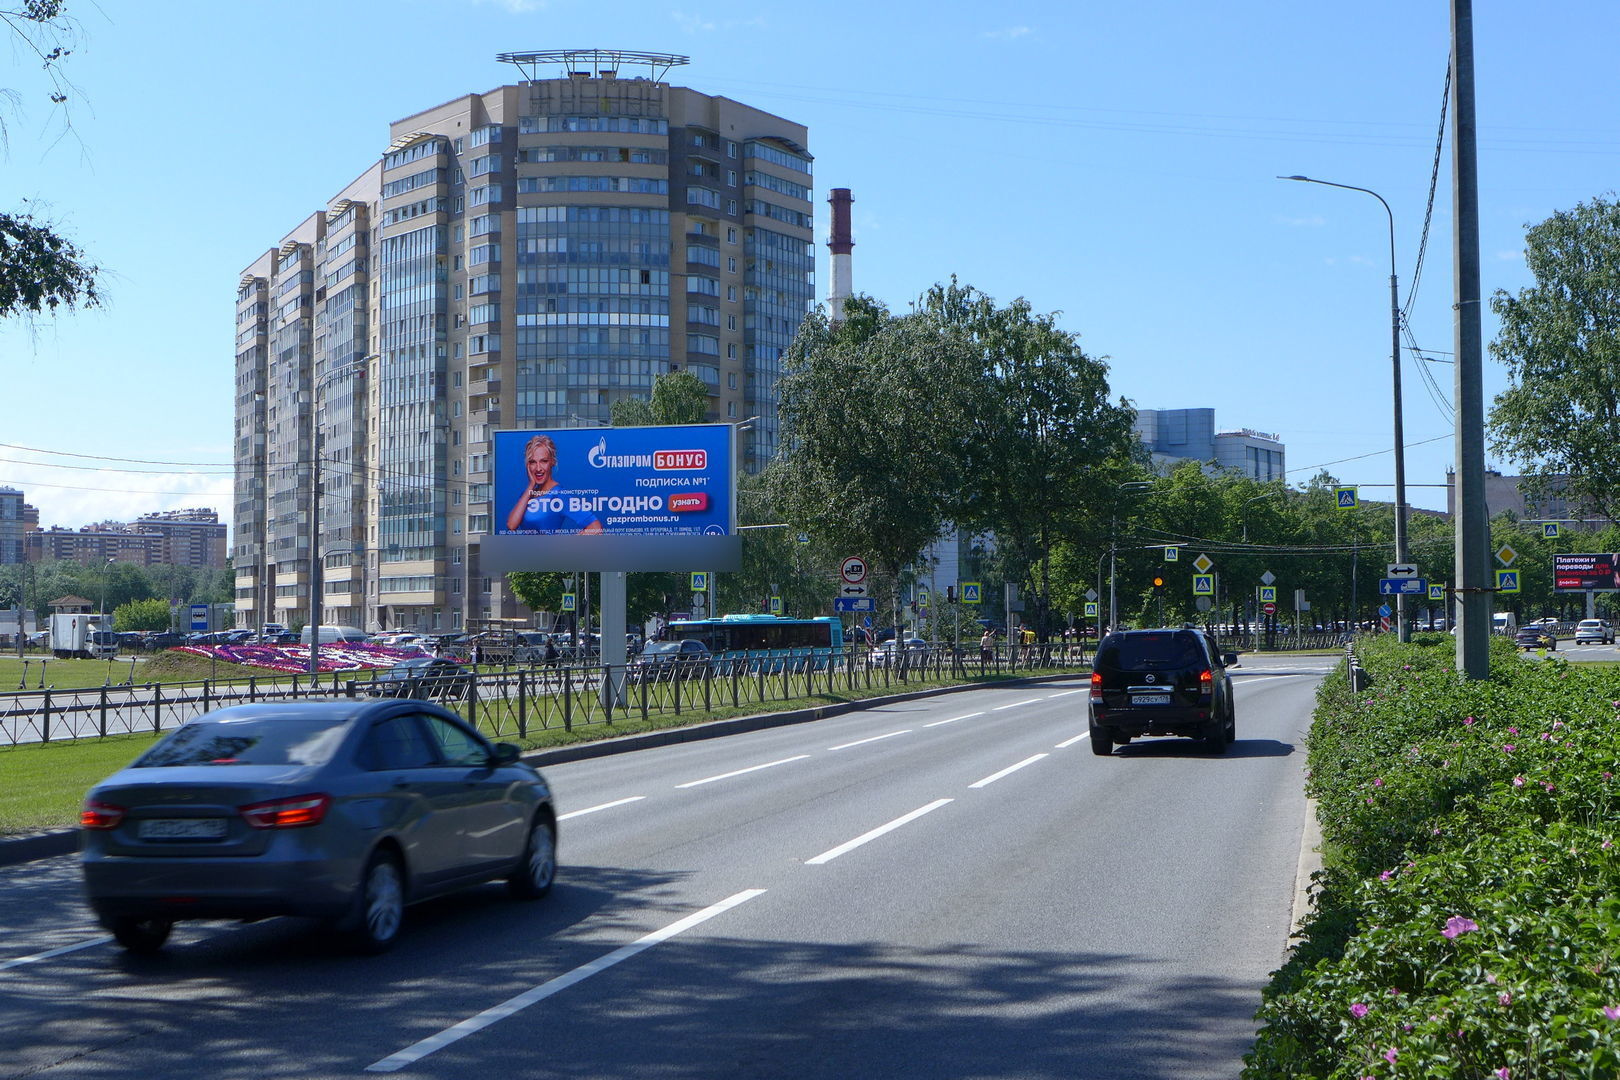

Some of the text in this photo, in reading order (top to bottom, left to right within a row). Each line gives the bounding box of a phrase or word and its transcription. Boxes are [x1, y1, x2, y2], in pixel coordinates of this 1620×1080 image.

[607, 453, 703, 468] ГАЗПРОМ БОНУС
[635, 477, 690, 487] ПОДПИСКА
[526, 496, 700, 513] ЭТО ВЫГОДНО узнать
[606, 514, 680, 524] gazprombonus.ru
